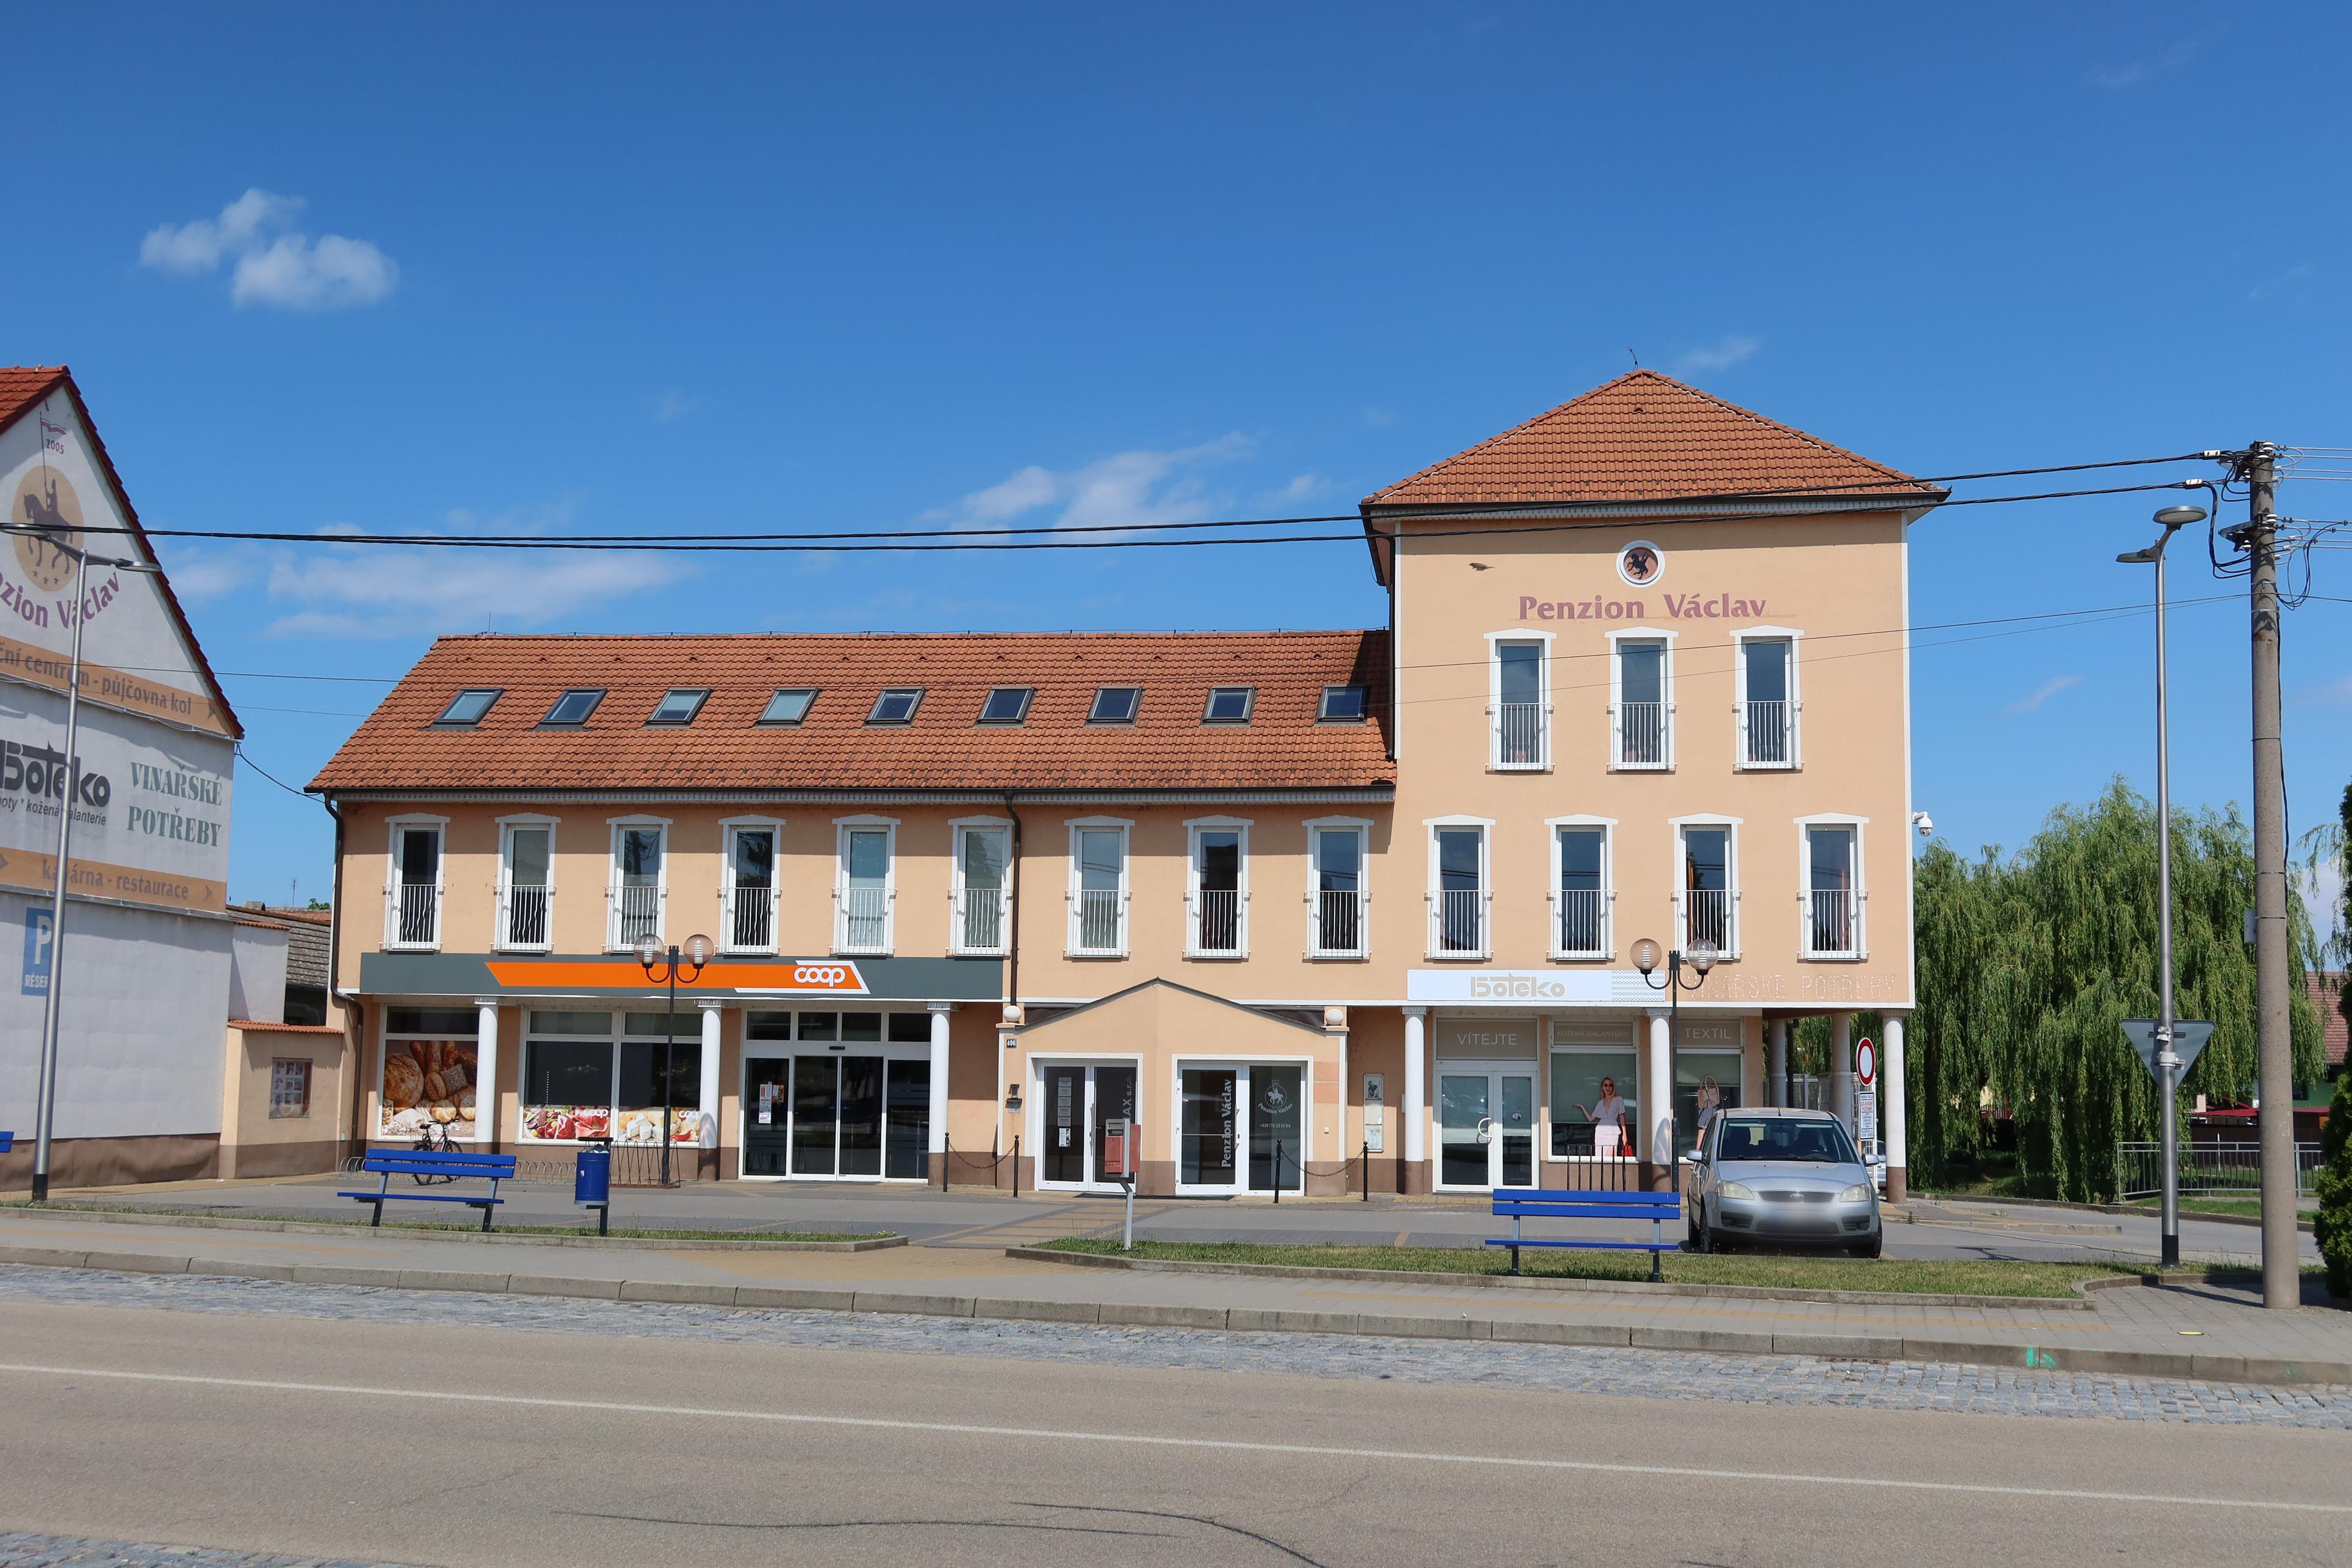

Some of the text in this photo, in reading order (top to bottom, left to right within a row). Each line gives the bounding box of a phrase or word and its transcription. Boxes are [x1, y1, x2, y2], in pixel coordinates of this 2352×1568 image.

[46, 438, 64, 454] 2005
[0, 571, 48, 629] zion
[1518, 593, 1767, 620] Penzion Václav
[101, 674, 167, 709] půjčovna
[171, 692, 191, 715] kol
[130, 761, 222, 806] VINAŘSKÉ
[0, 796, 17, 812] oty
[26, 799, 60, 817] kožená
[70, 807, 106, 825] alanterie
[127, 805, 222, 847] POTŘEBY
[116, 874, 189, 899] restaurace
[35, 916, 54, 965] P
[794, 967, 846, 987] coop
[1457, 1032, 1517, 1045] VÍTEJTE
[1684, 1028, 1731, 1039] TEXTIL
[584, 1108, 609, 1119] coop
[1122, 1098, 1132, 1119] AX
[1258, 1102, 1293, 1113] Penzion Václav
[1222, 1079, 1232, 1168] Penzion Václav
